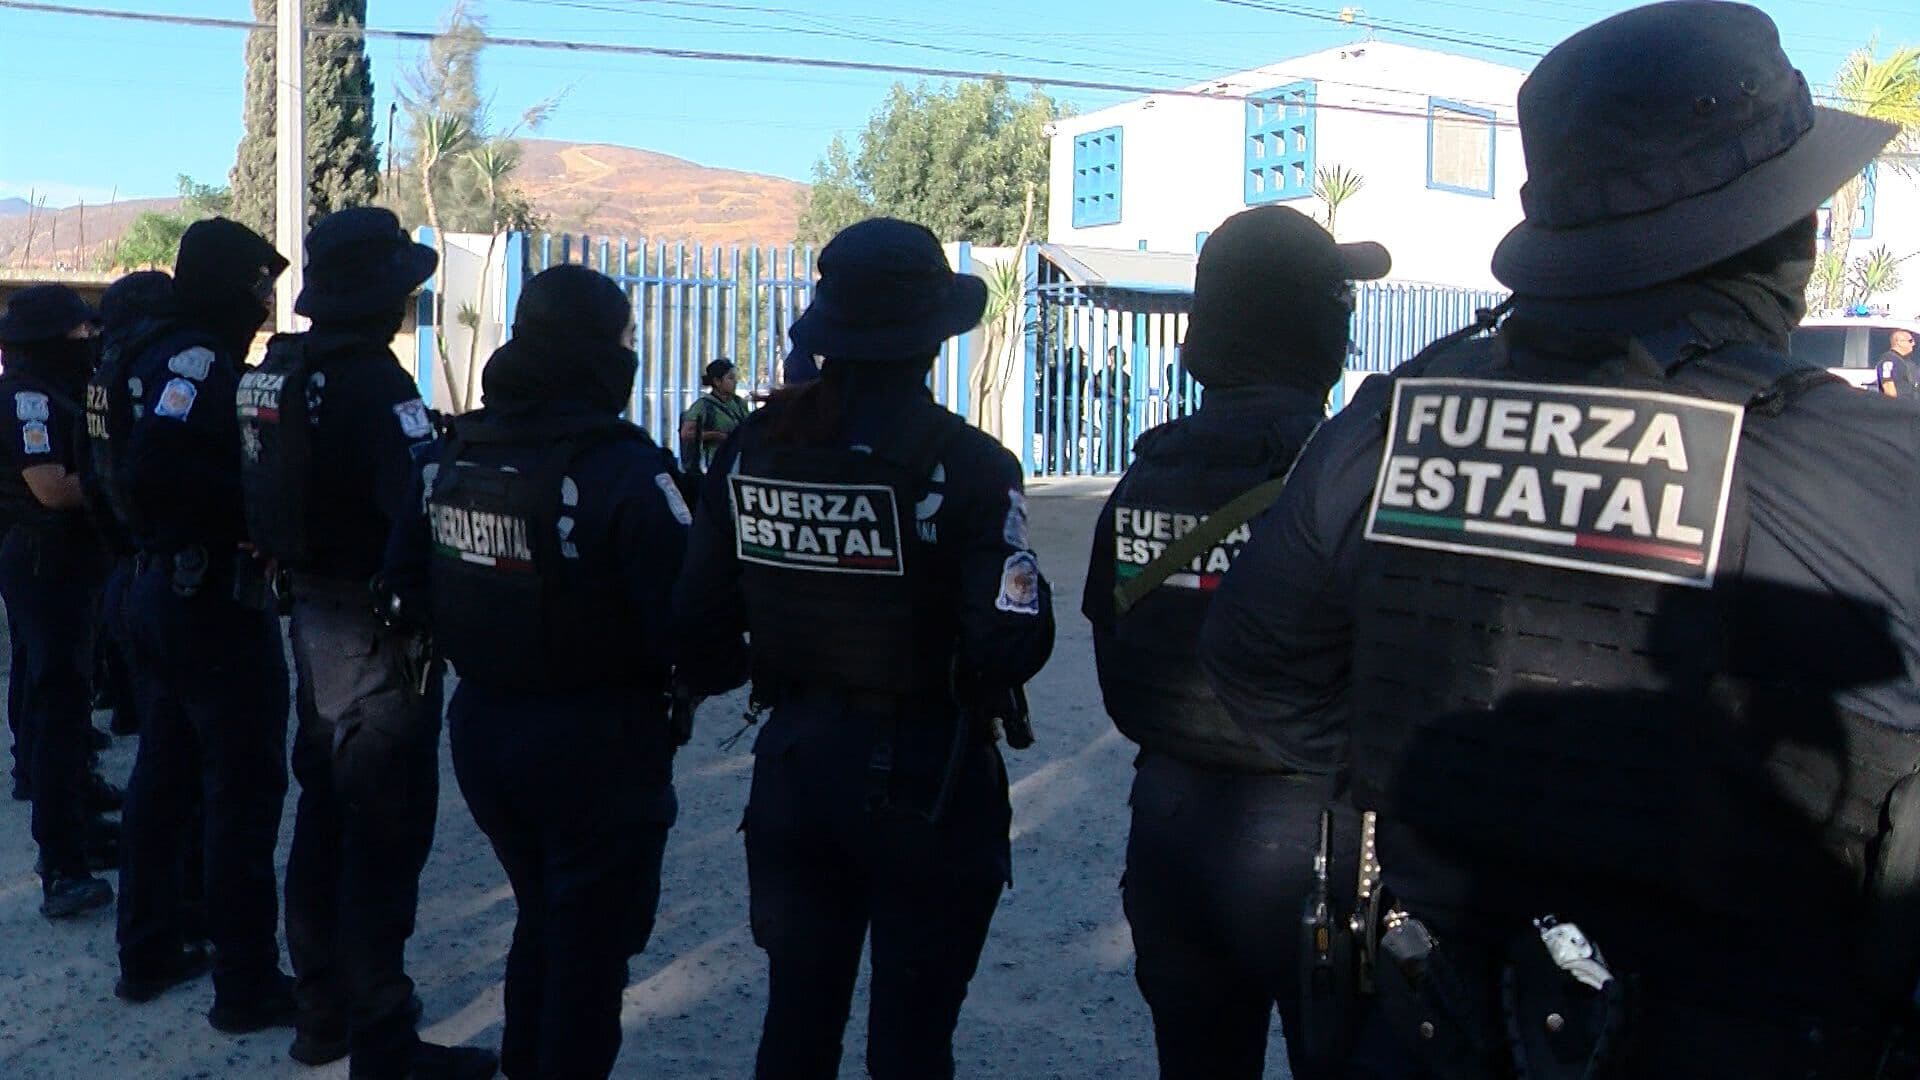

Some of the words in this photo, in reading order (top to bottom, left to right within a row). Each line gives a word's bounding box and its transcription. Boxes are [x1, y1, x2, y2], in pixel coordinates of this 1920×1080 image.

[1407, 395, 1688, 472] FUERZA
[741, 485, 877, 523] FUERZA
[1381, 455, 1704, 545] ESTATAL
[472, 510, 531, 560] ESTATAL
[741, 514, 893, 556] ESTATAL
[1115, 506, 1252, 545] FUERA
